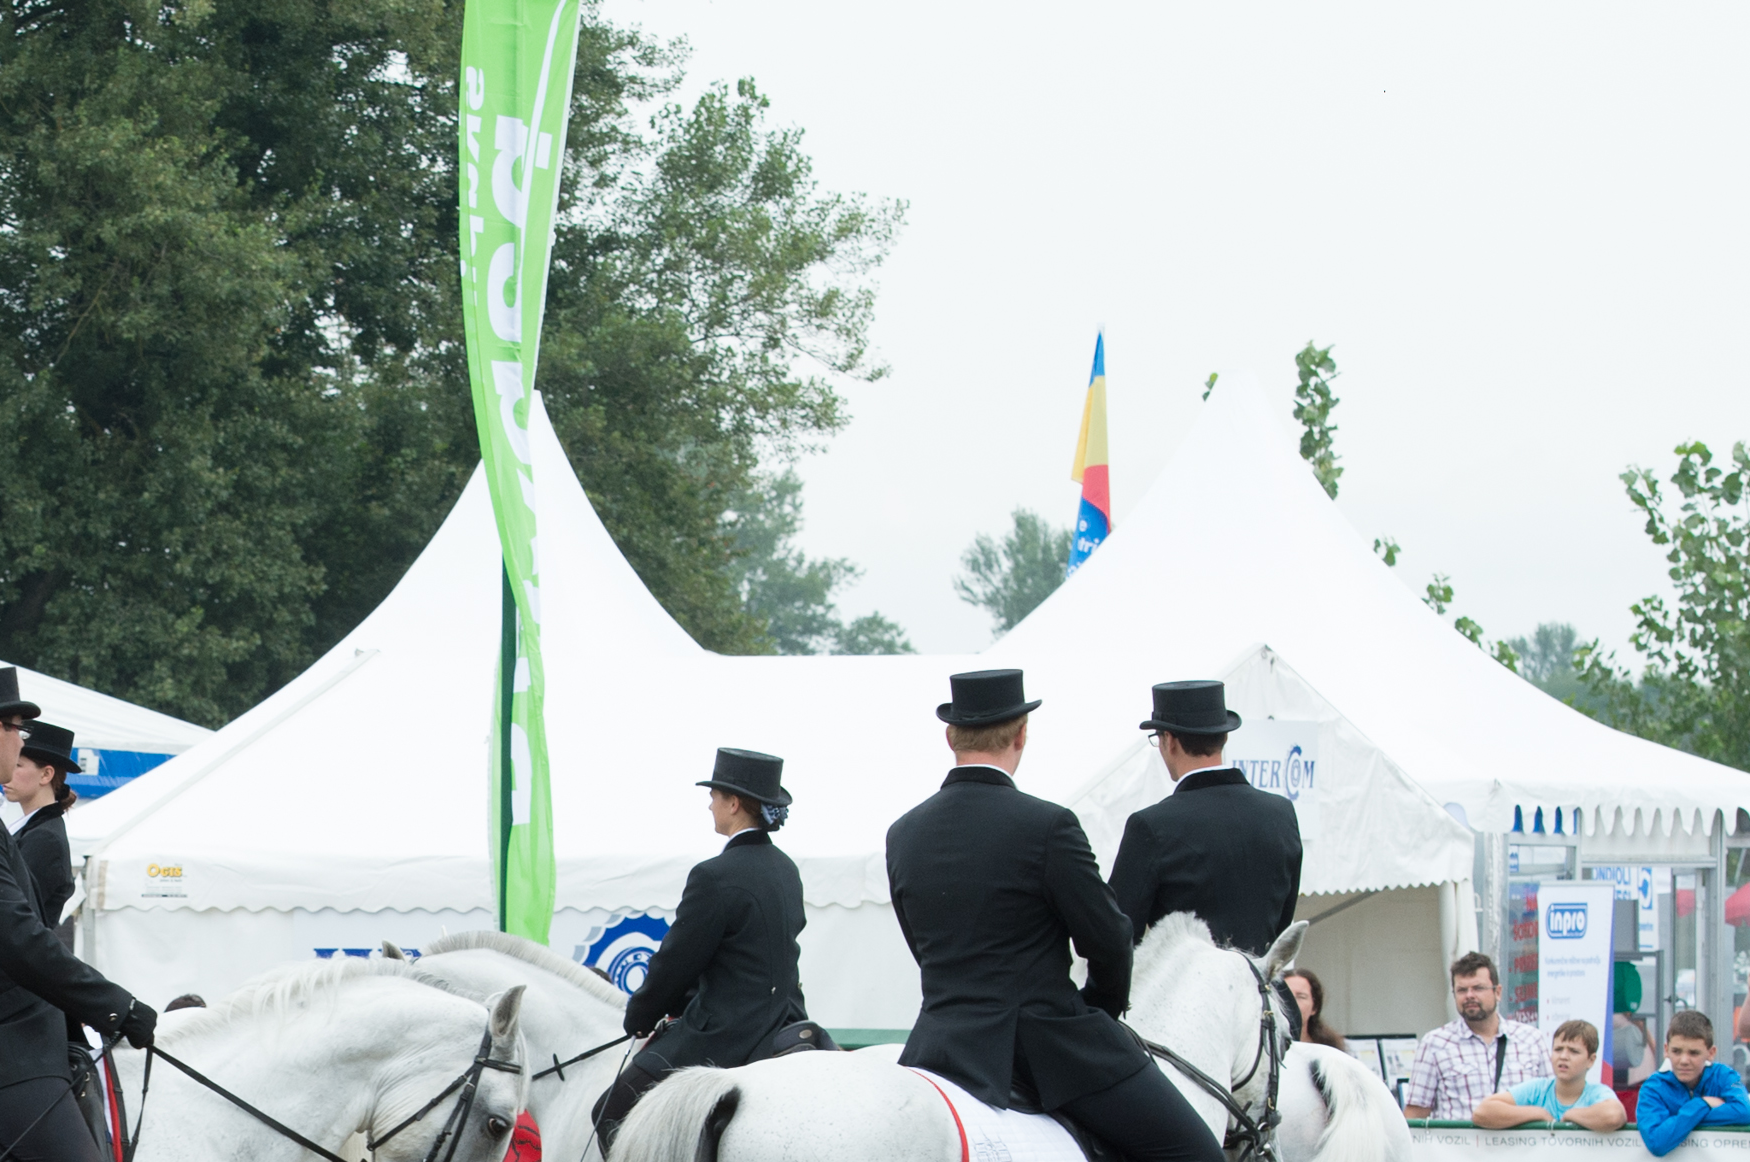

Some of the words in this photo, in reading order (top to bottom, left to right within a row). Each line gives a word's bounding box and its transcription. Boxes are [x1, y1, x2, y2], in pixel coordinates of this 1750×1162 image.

[1232, 744, 1315, 801] NTERCOM
[1550, 904, 1586, 935] inpro
[1436, 1135, 1471, 1146] VOZIL
[1485, 1136, 1537, 1147] LEASING
[1542, 1137, 1603, 1147] TOVORNIH
[1608, 1137, 1641, 1148] VOZIL
[1679, 1138, 1709, 1148] SING
[1713, 1139, 1750, 1150] OPRE
